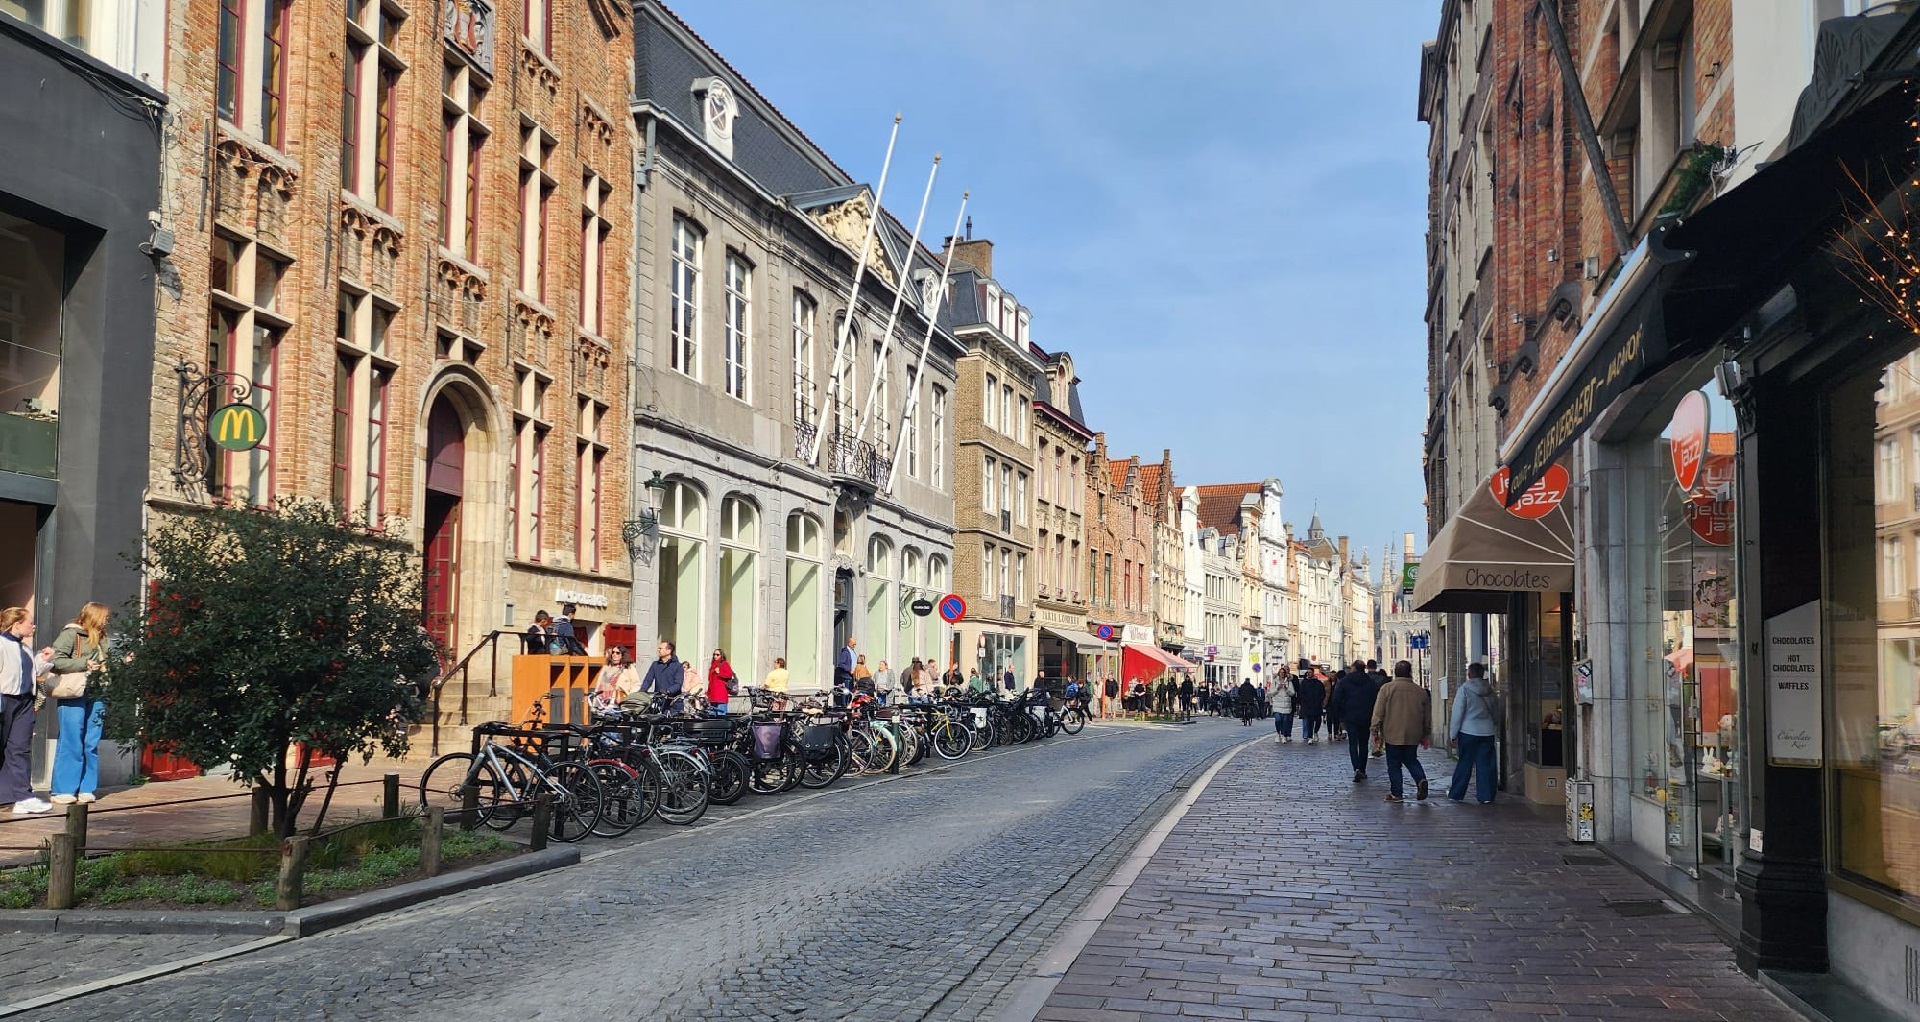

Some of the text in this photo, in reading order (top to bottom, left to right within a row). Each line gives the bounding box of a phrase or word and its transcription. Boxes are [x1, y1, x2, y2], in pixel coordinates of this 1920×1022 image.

[1514, 490, 1560, 511] jazz
[1466, 568, 1550, 589] Chocolates
[1772, 637, 1815, 645] CHOCOLATES
[1787, 654, 1800, 662] HOT
[1772, 664, 1815, 672] CHOCOLATES
[1778, 682, 1810, 690] WAFFLES
